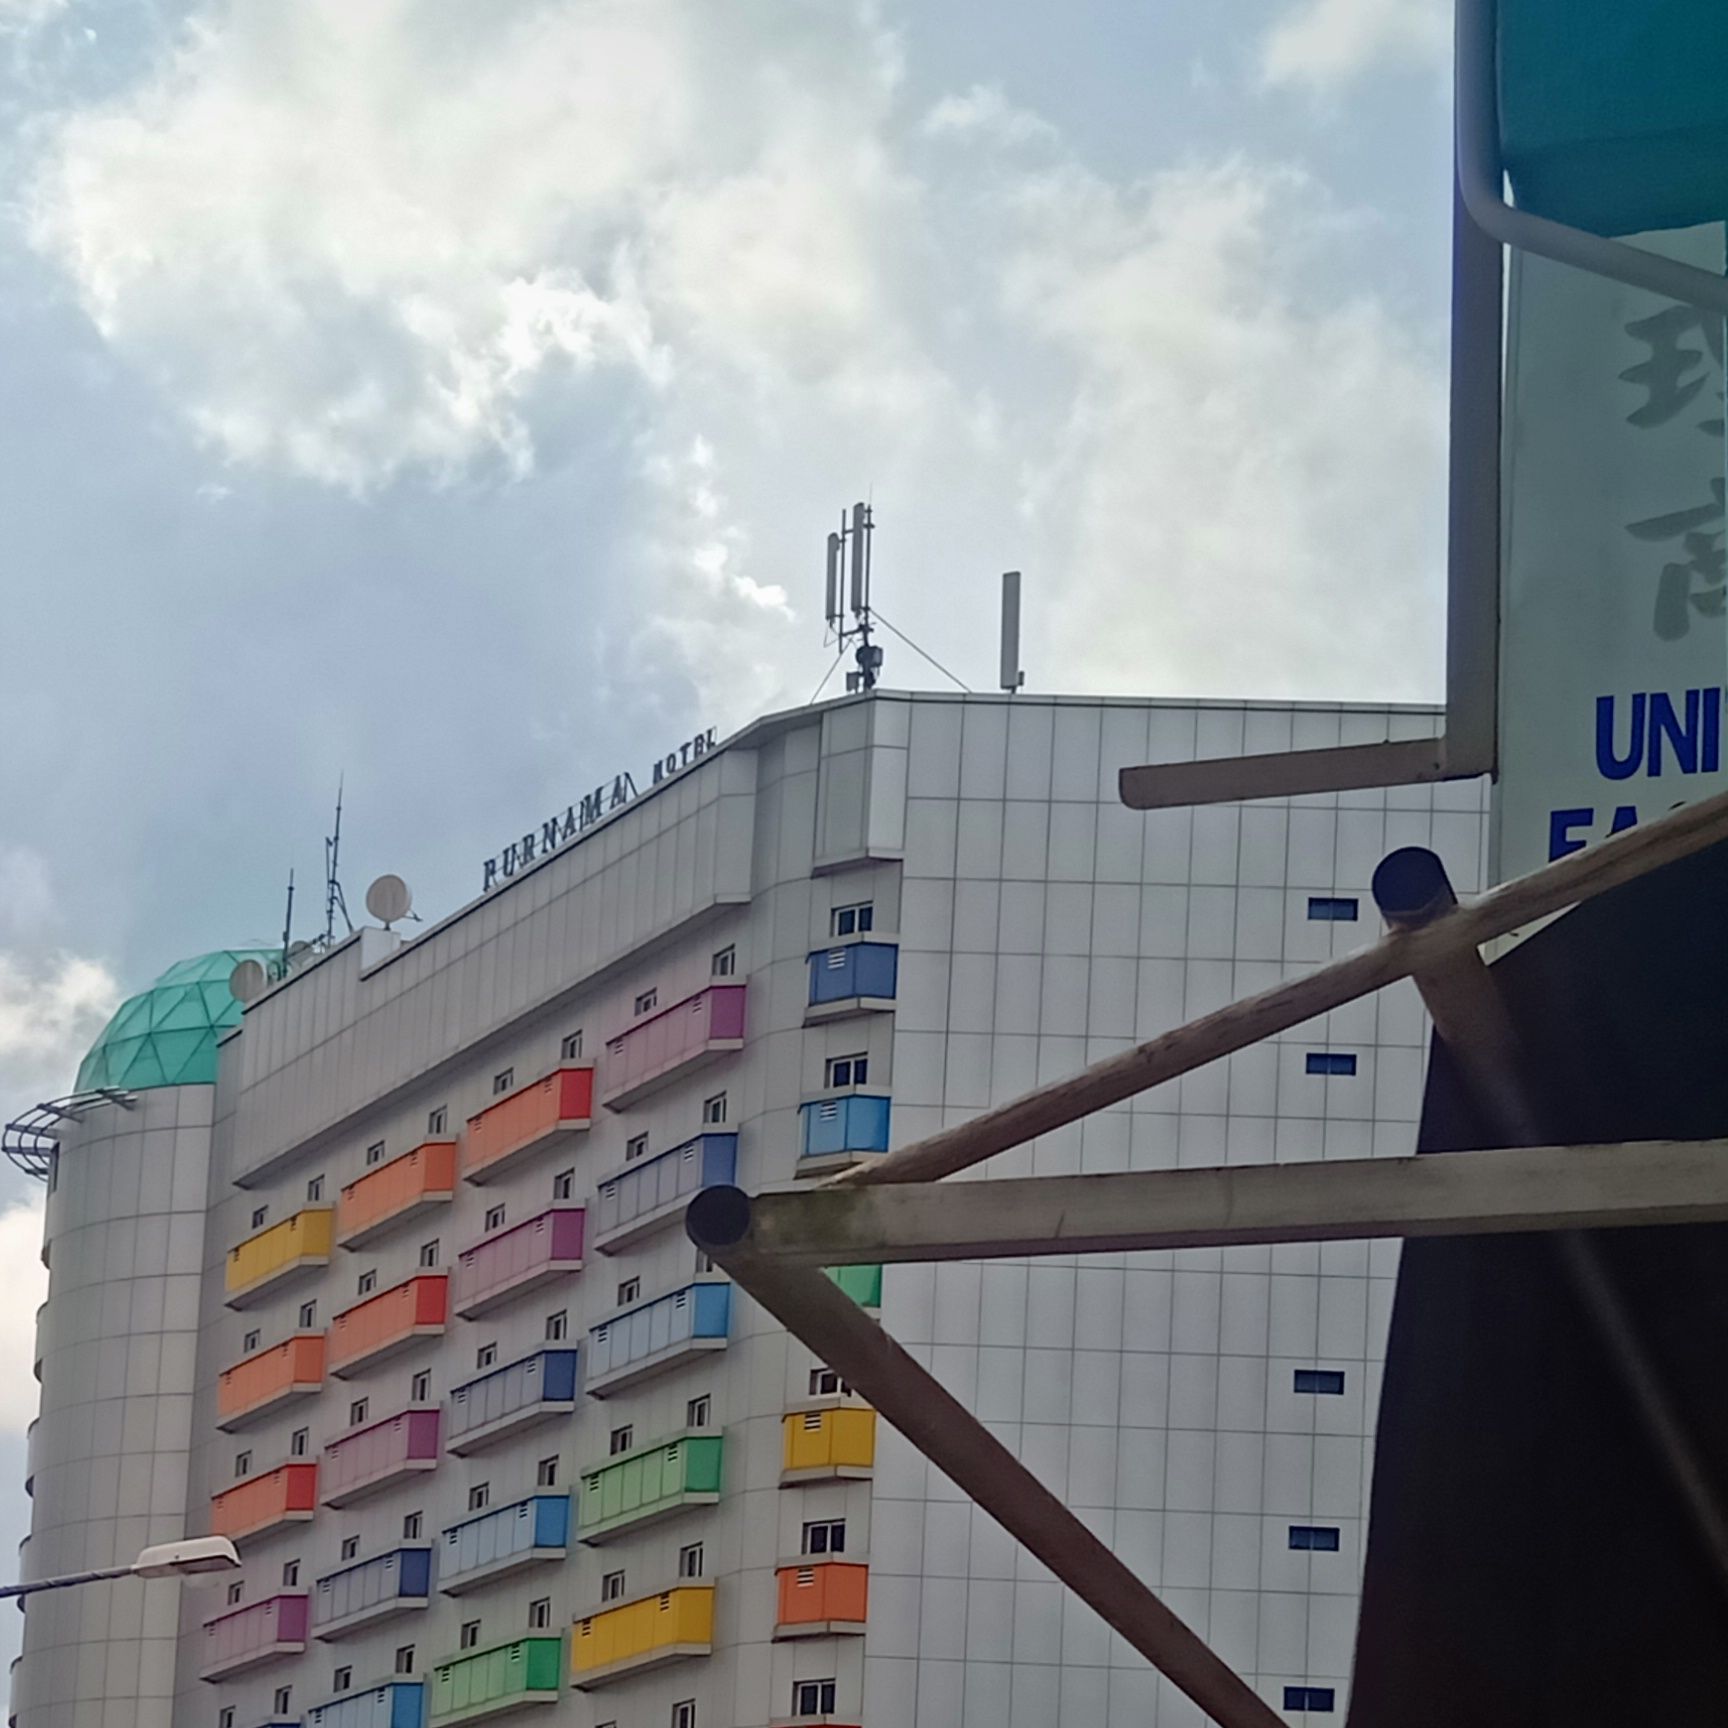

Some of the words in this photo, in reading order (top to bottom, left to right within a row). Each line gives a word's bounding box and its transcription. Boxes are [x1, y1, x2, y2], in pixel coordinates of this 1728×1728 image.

[1595, 686, 1721, 781] UNI
[482, 772, 638, 891] PURNAMA
[652, 726, 717, 784] HOTEL
